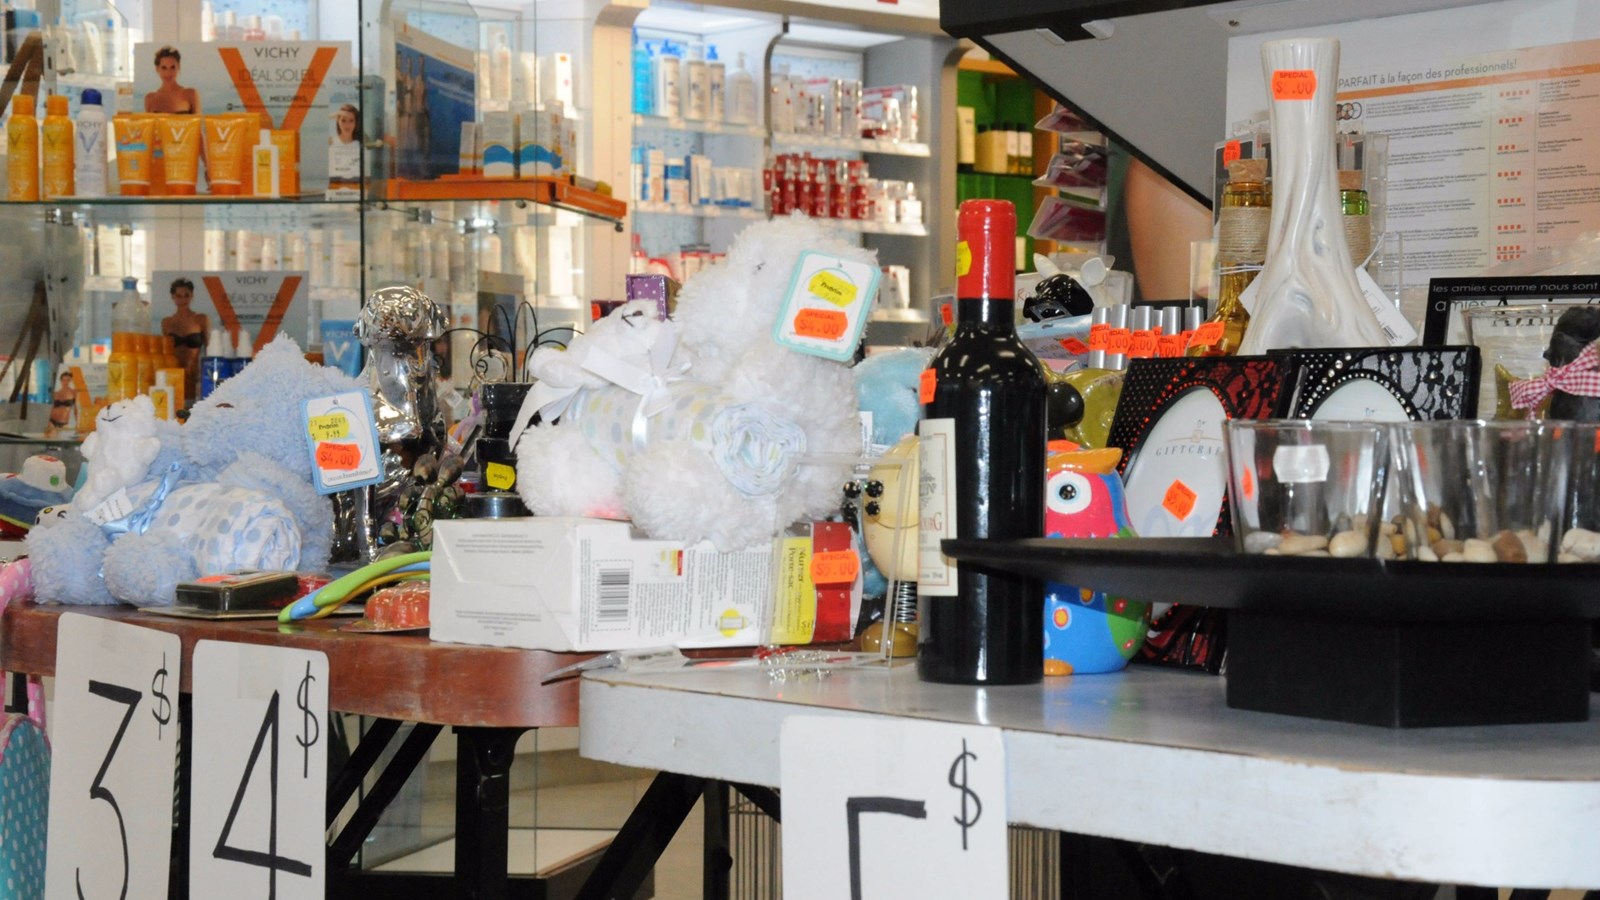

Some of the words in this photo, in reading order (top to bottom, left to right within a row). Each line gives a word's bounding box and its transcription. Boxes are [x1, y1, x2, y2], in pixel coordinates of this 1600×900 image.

[254, 47, 300, 58] VICHY
[238, 65, 271, 81] IDÉAL
[275, 68, 314, 81] SOLEIL
[1280, 71, 1308, 79] SPECIAL
[1338, 74, 1377, 88] PARFAIT
[1380, 75, 1386, 84] à
[1387, 73, 1396, 84] la
[1397, 70, 1423, 84] façon
[1425, 68, 1442, 80] des
[1444, 59, 1517, 79] professionnels!
[1276, 81, 1312, 95] $.00
[236, 276, 268, 285] VICHY
[1432, 285, 1448, 293] les
[1451, 284, 1487, 292] amies
[1489, 284, 1537, 292] comme
[1540, 283, 1569, 291] nous
[1572, 282, 1598, 290] sont
[805, 311, 835, 320] SPECIAL
[325, 443, 351, 452] SPECIAL
[1155, 445, 1223, 456] GIFTCRAF
[320, 451, 354, 466] $4.00
[820, 552, 850, 561] SPECIAL
[788, 547, 796, 589] Porte-sac
